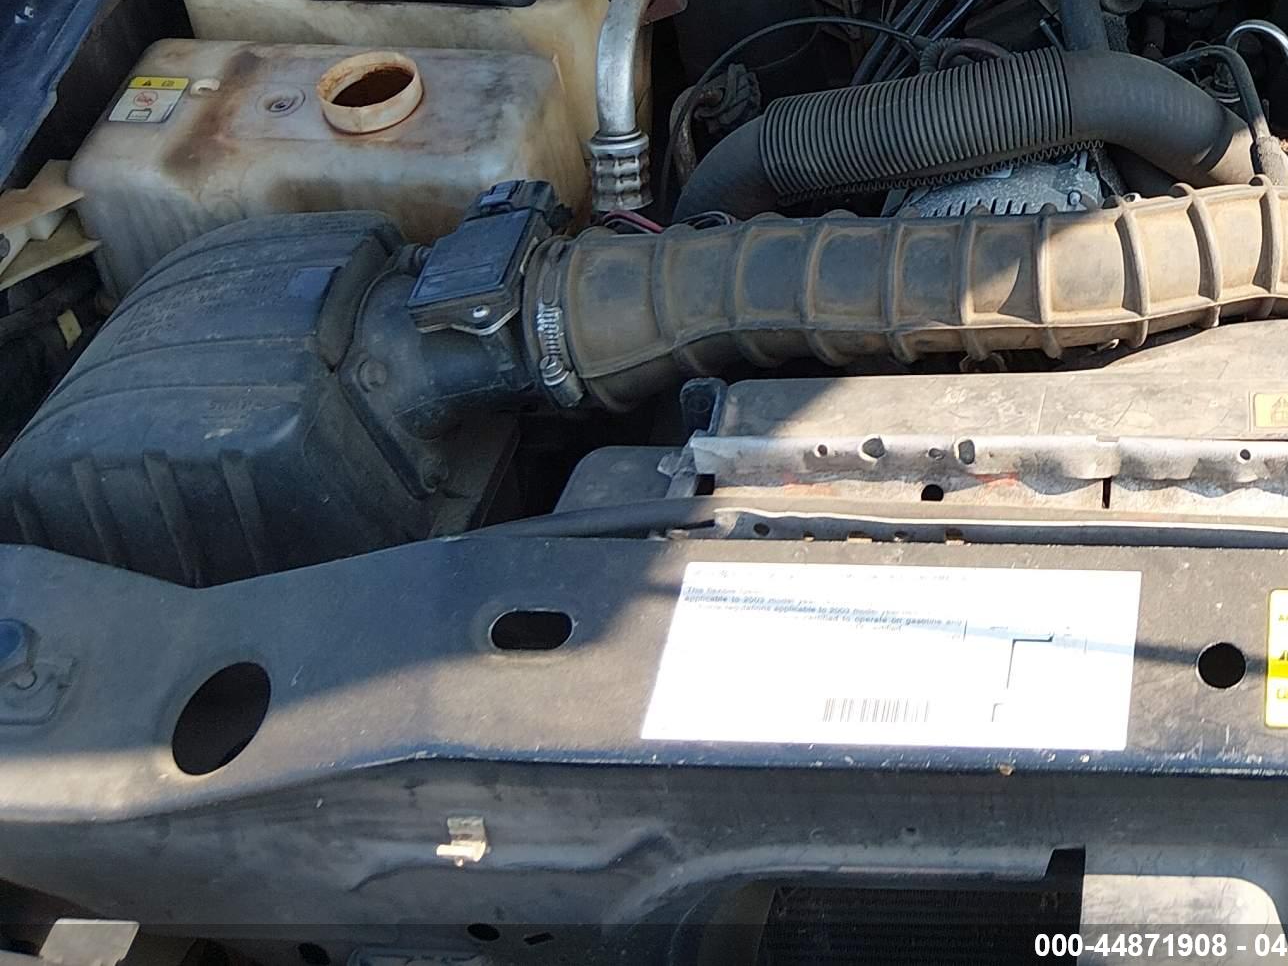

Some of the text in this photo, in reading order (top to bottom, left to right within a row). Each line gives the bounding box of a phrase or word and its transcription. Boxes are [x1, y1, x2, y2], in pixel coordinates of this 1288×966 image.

[773, 605, 816, 614] applicable
[854, 616, 888, 625] operate
[905, 618, 942, 626] gasoline
